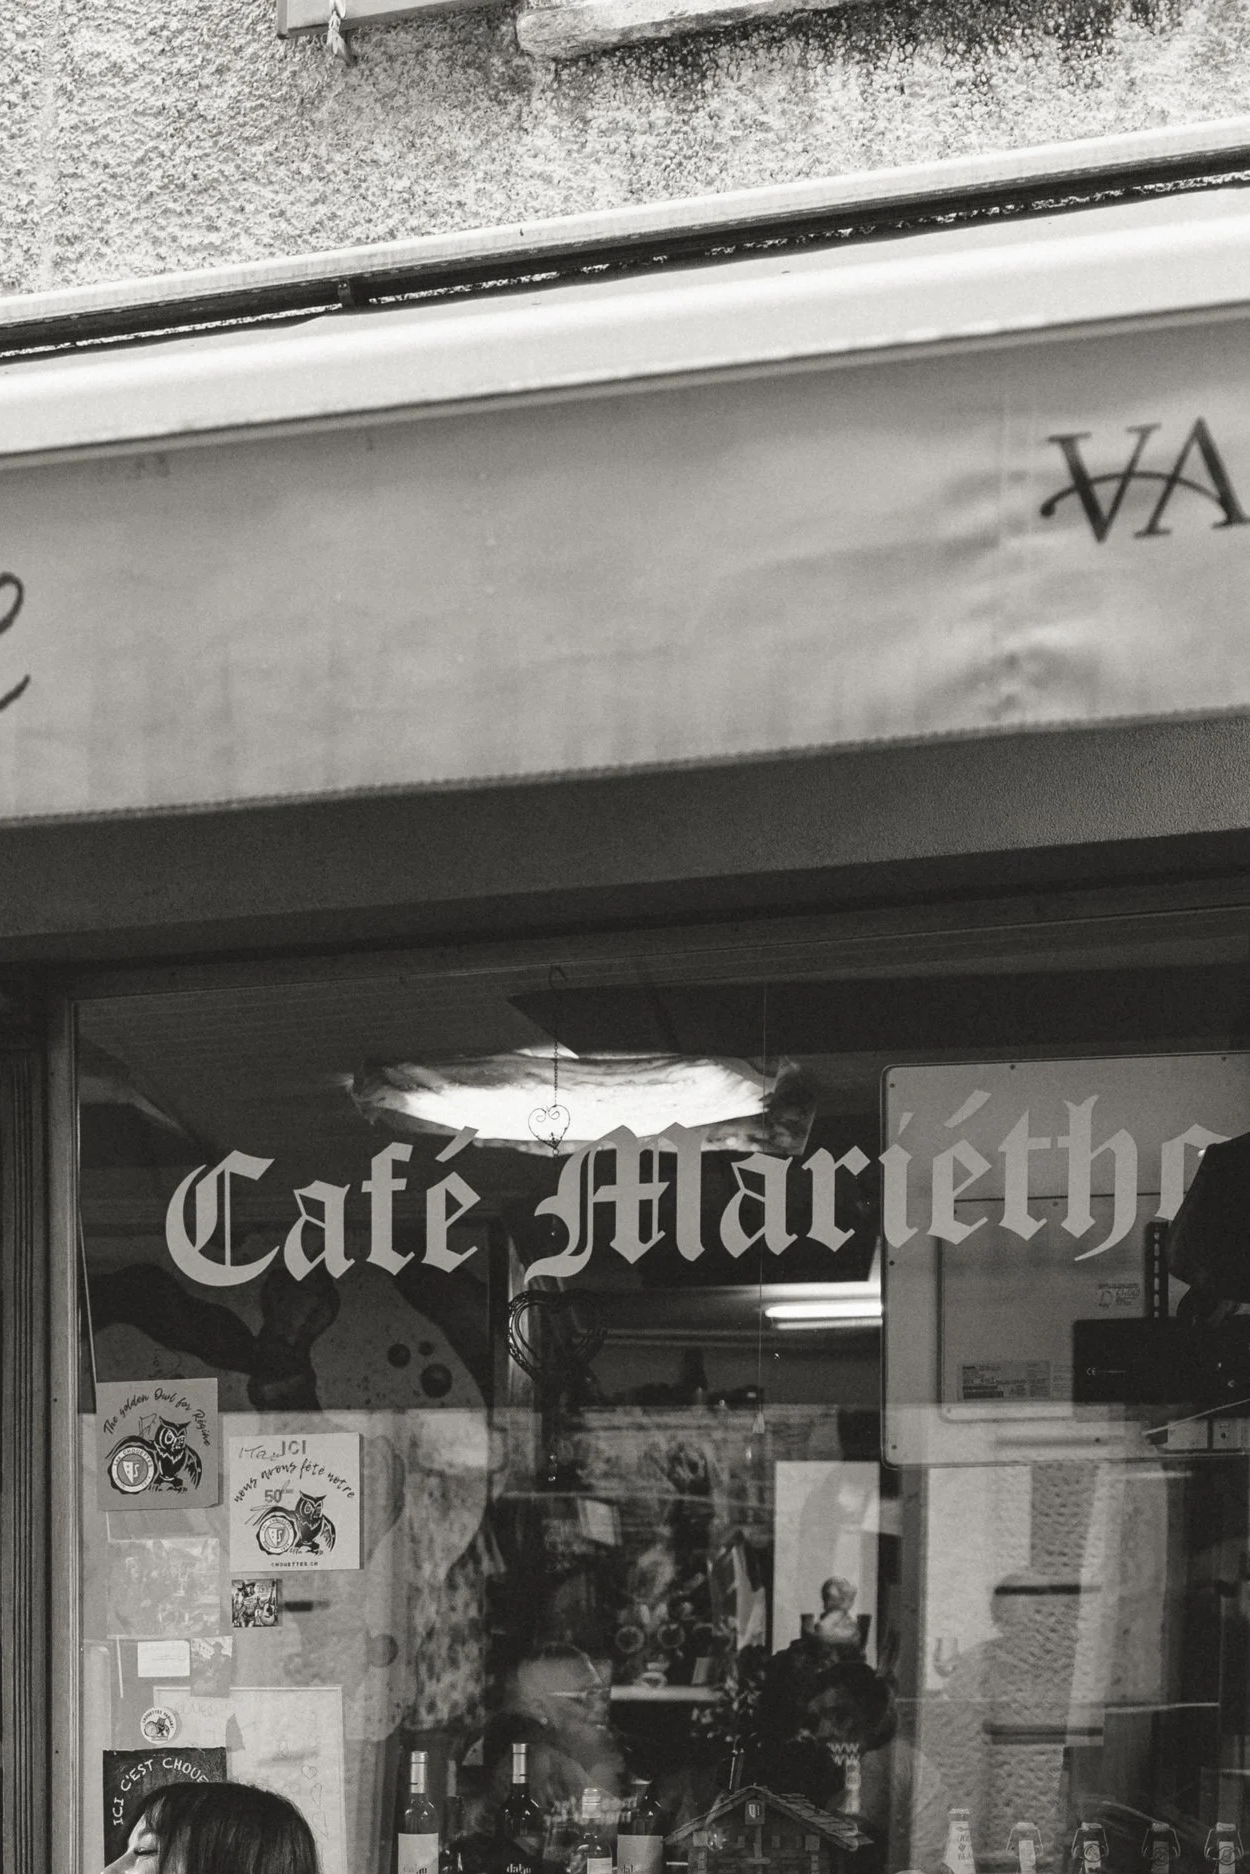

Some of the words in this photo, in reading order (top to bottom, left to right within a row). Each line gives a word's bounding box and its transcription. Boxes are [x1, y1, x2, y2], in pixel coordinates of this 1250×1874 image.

[163, 1124, 482, 1288] Café
[103, 1416, 118, 1435] The
[119, 1393, 149, 1418] golden
[154, 1387, 177, 1403] Owl
[175, 1397, 192, 1410] for
[234, 1477, 258, 1503] nous
[261, 1461, 296, 1480] avons
[327, 1472, 355, 1499] notre
[112, 1797, 125, 1827] ICI
[121, 1759, 154, 1792] C'EST
